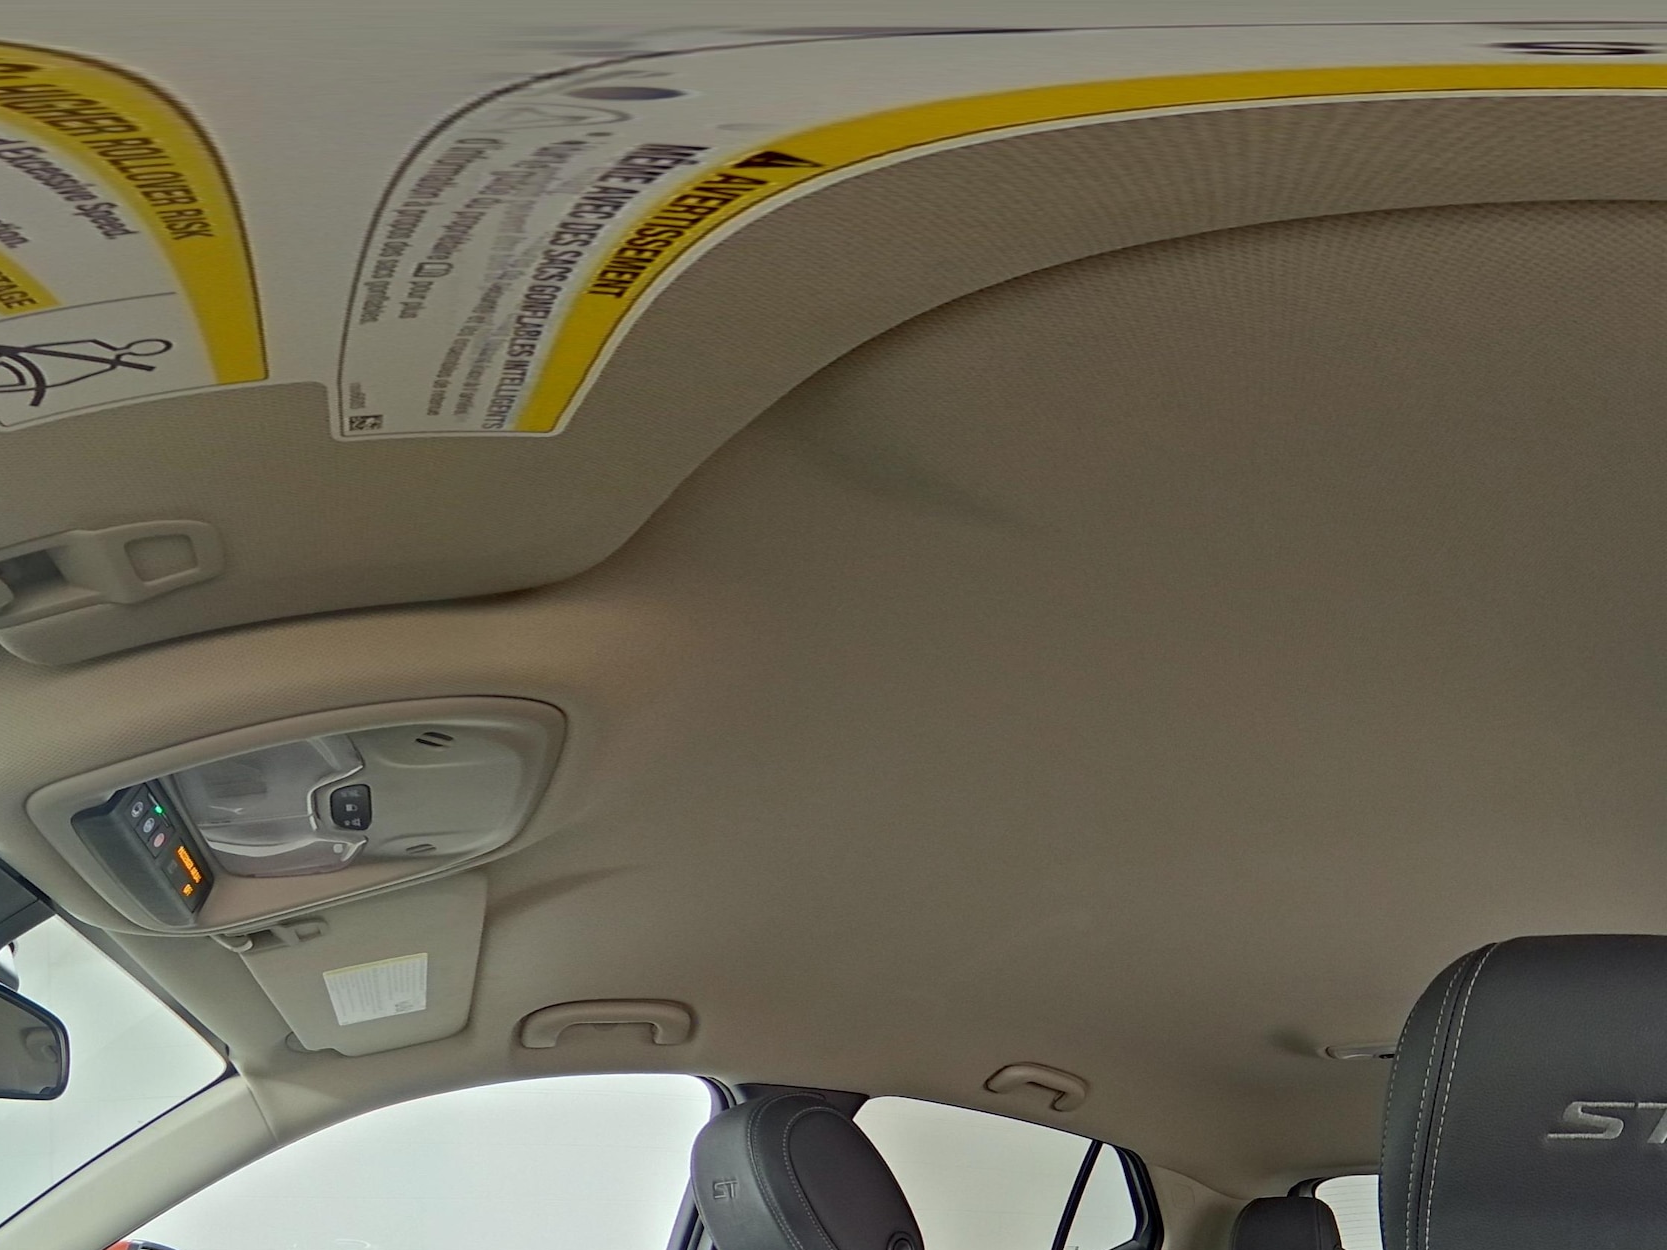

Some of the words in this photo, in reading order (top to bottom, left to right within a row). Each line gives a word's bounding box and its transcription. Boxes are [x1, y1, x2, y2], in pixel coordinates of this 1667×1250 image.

[567, 184, 640, 220] AVEC
[548, 221, 604, 247] DES
[587, 172, 768, 298] AVERTISSEMENT
[531, 248, 583, 282] SACS
[506, 283, 562, 357] GONFLABLES
[481, 359, 530, 429] INTELLIGENTS
